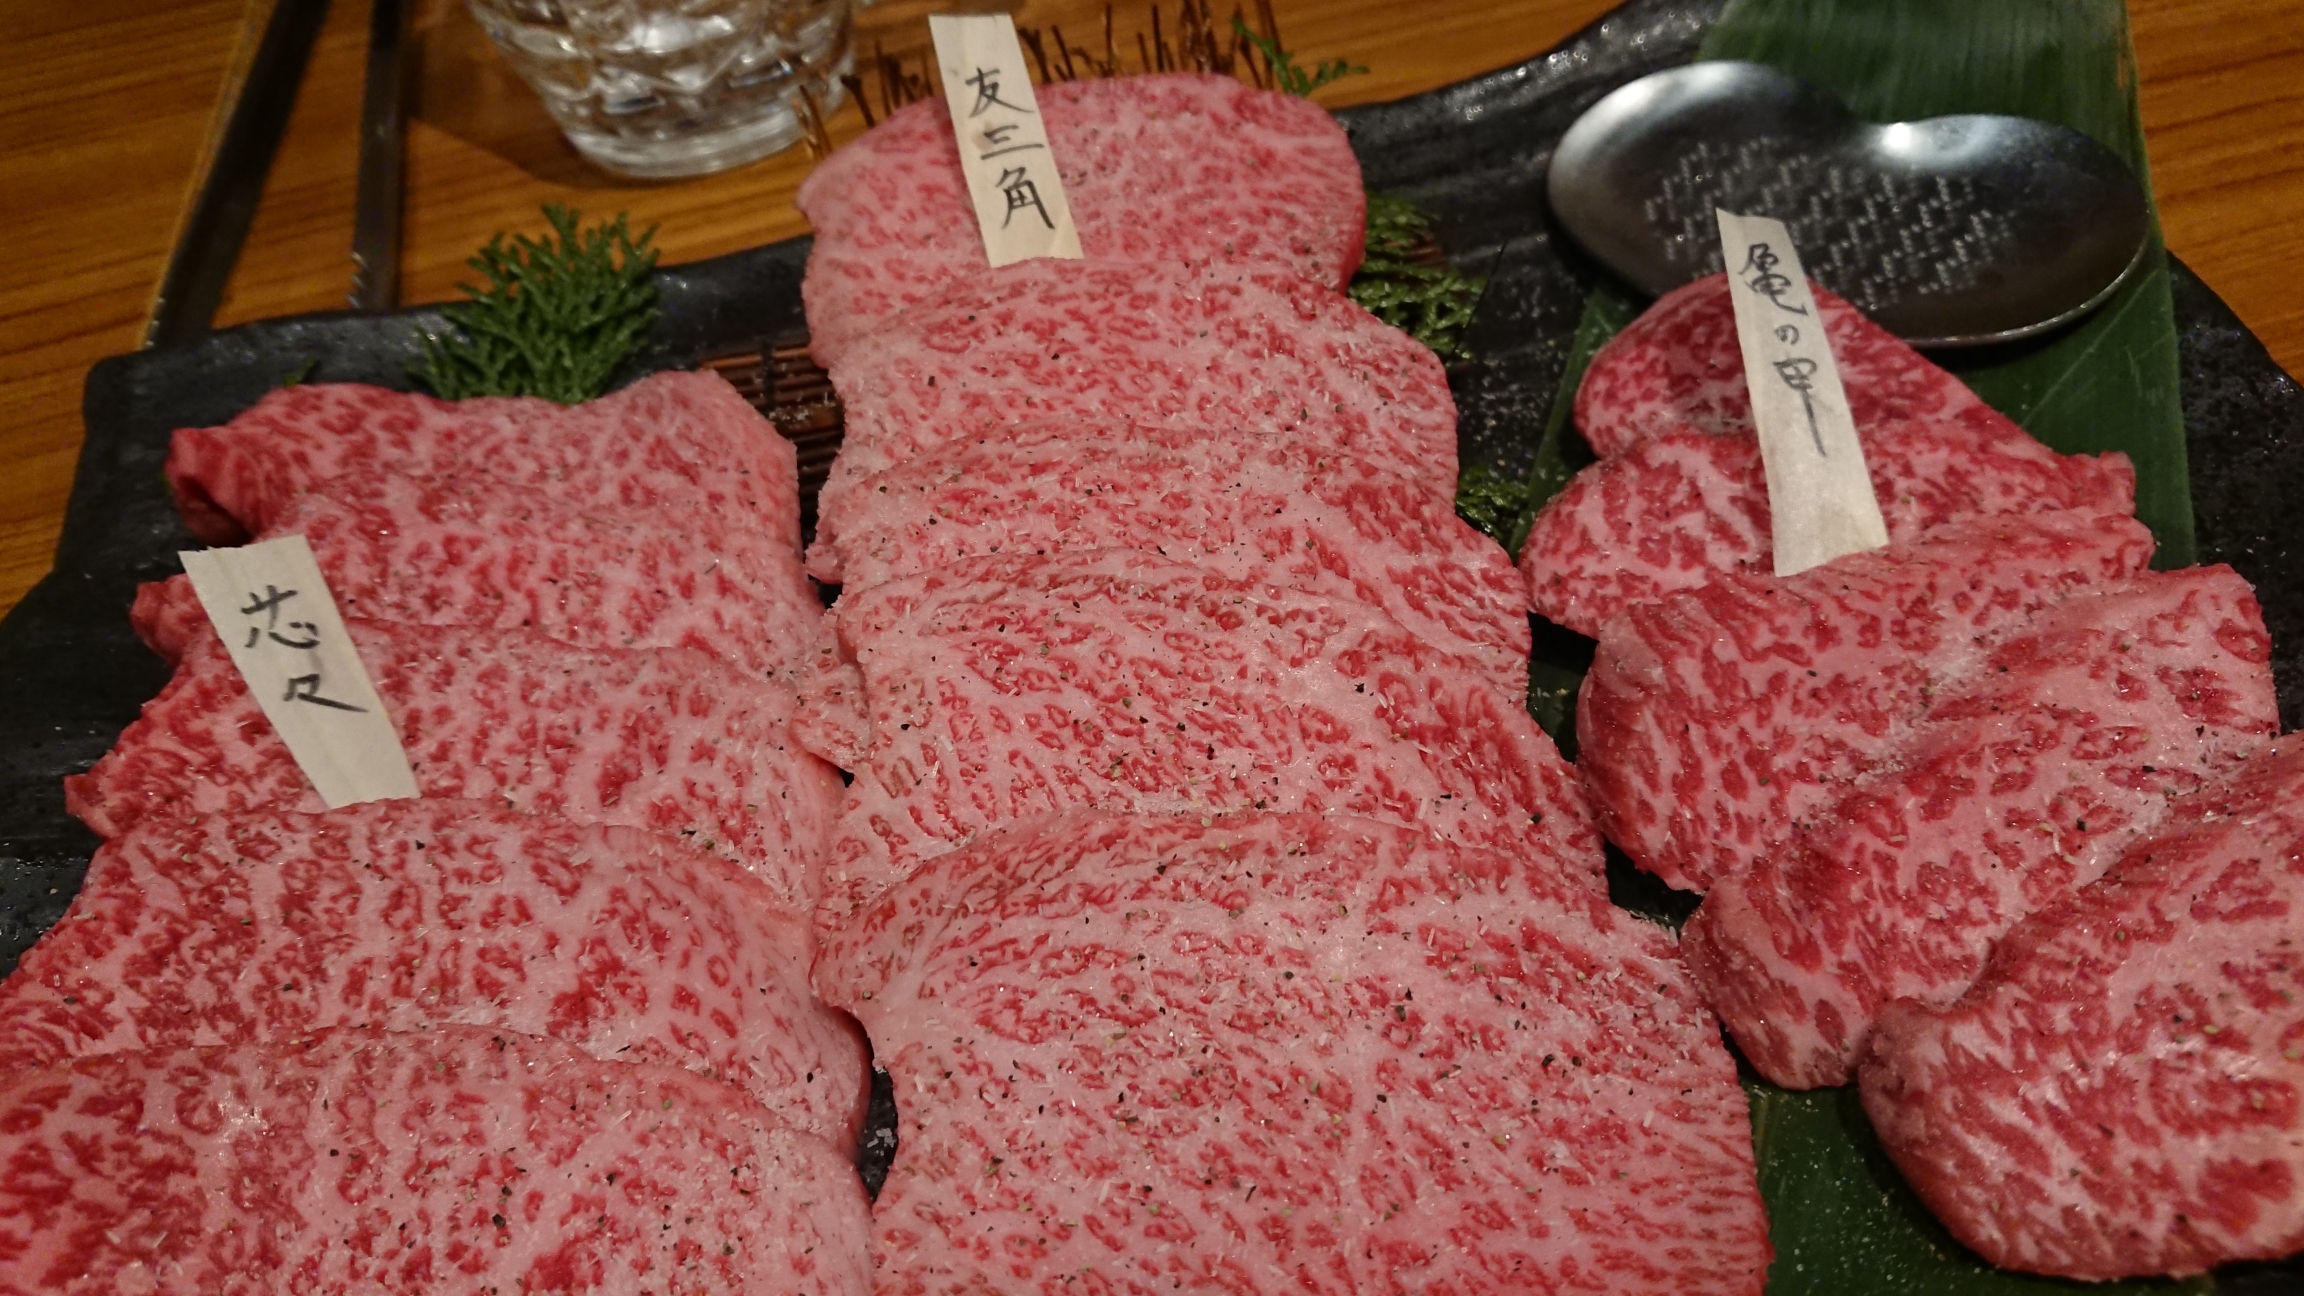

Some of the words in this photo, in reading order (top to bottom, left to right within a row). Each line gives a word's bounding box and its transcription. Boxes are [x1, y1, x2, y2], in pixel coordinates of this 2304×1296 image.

[965, 66, 1056, 230] 友三角
[1738, 242, 1827, 458] 亀の甲
[240, 584, 370, 713] 芯々
